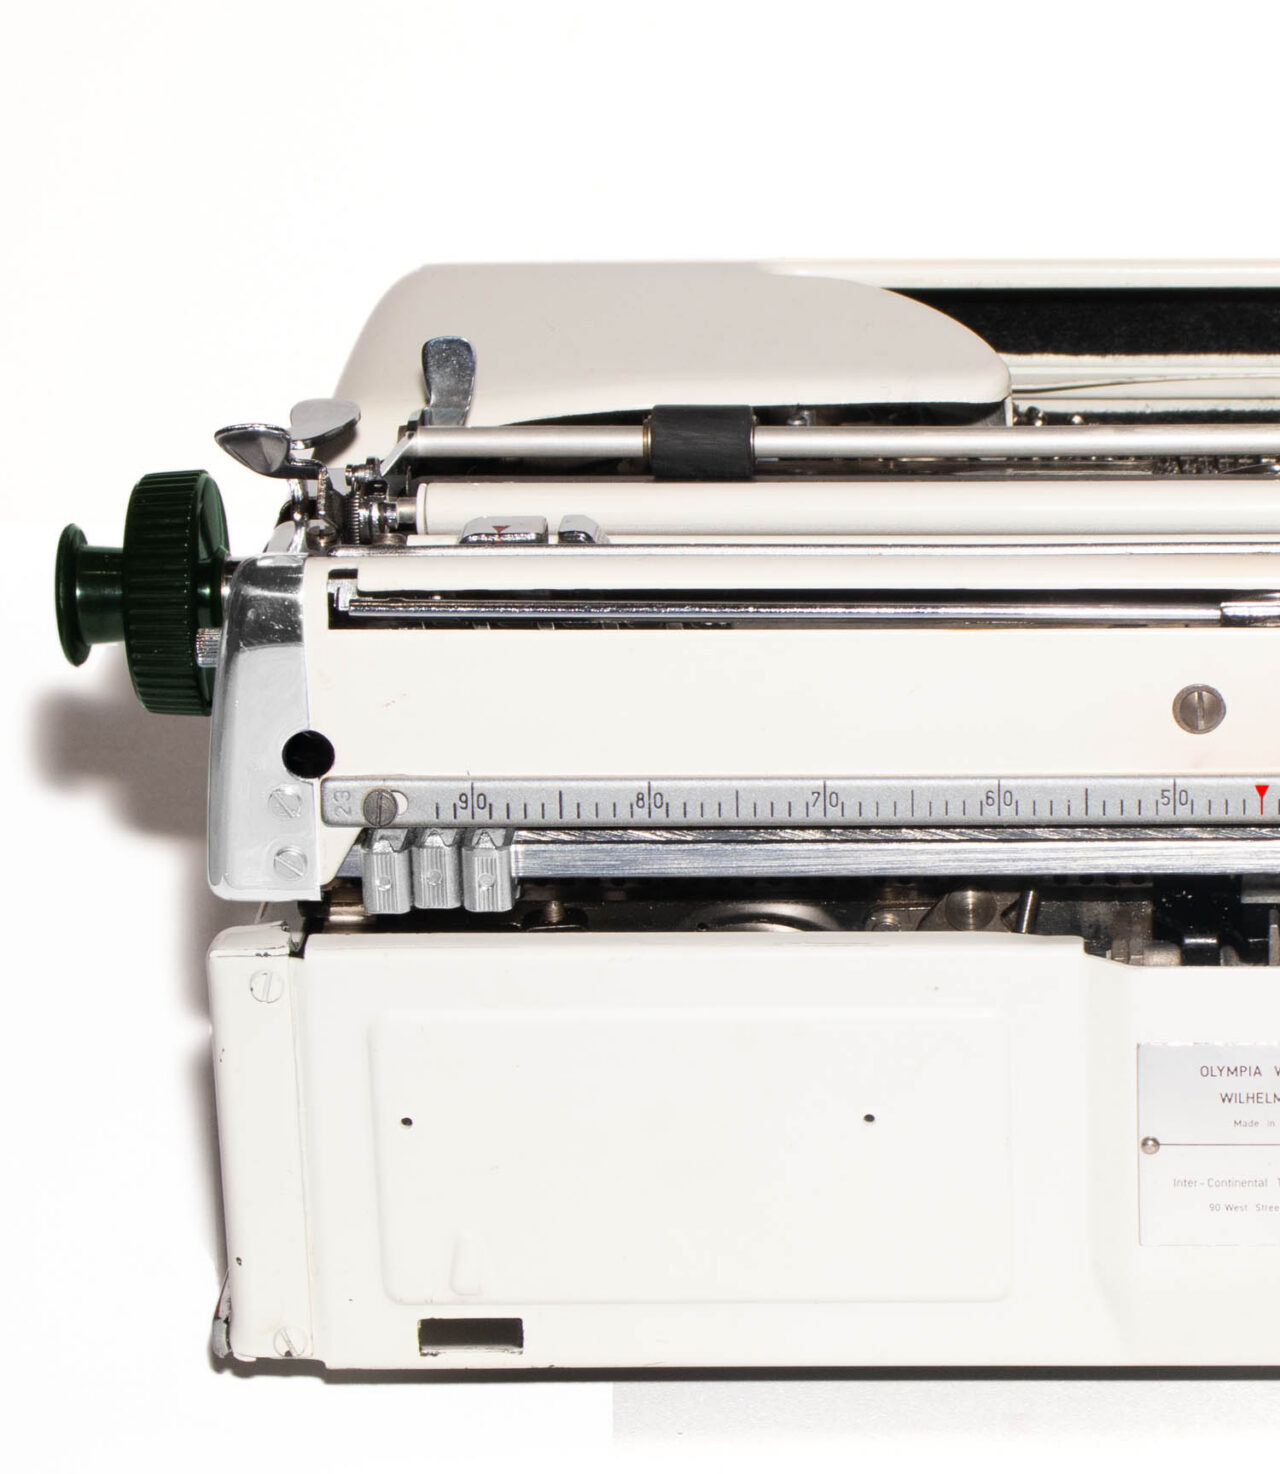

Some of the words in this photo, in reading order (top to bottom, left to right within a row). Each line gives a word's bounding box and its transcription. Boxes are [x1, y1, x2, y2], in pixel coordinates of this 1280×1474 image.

[459, 793, 487, 810] 90
[636, 791, 664, 809] 80
[811, 790, 839, 808] 70
[985, 790, 1013, 808] 60
[1160, 790, 1188, 807] 50
[1200, 1065, 1262, 1078] OLYMPIA
[1233, 1119, 1259, 1128] Made
[1267, 1119, 1275, 1128] in
[1209, 1203, 1221, 1212] 90
[1225, 1203, 1248, 1212] West
